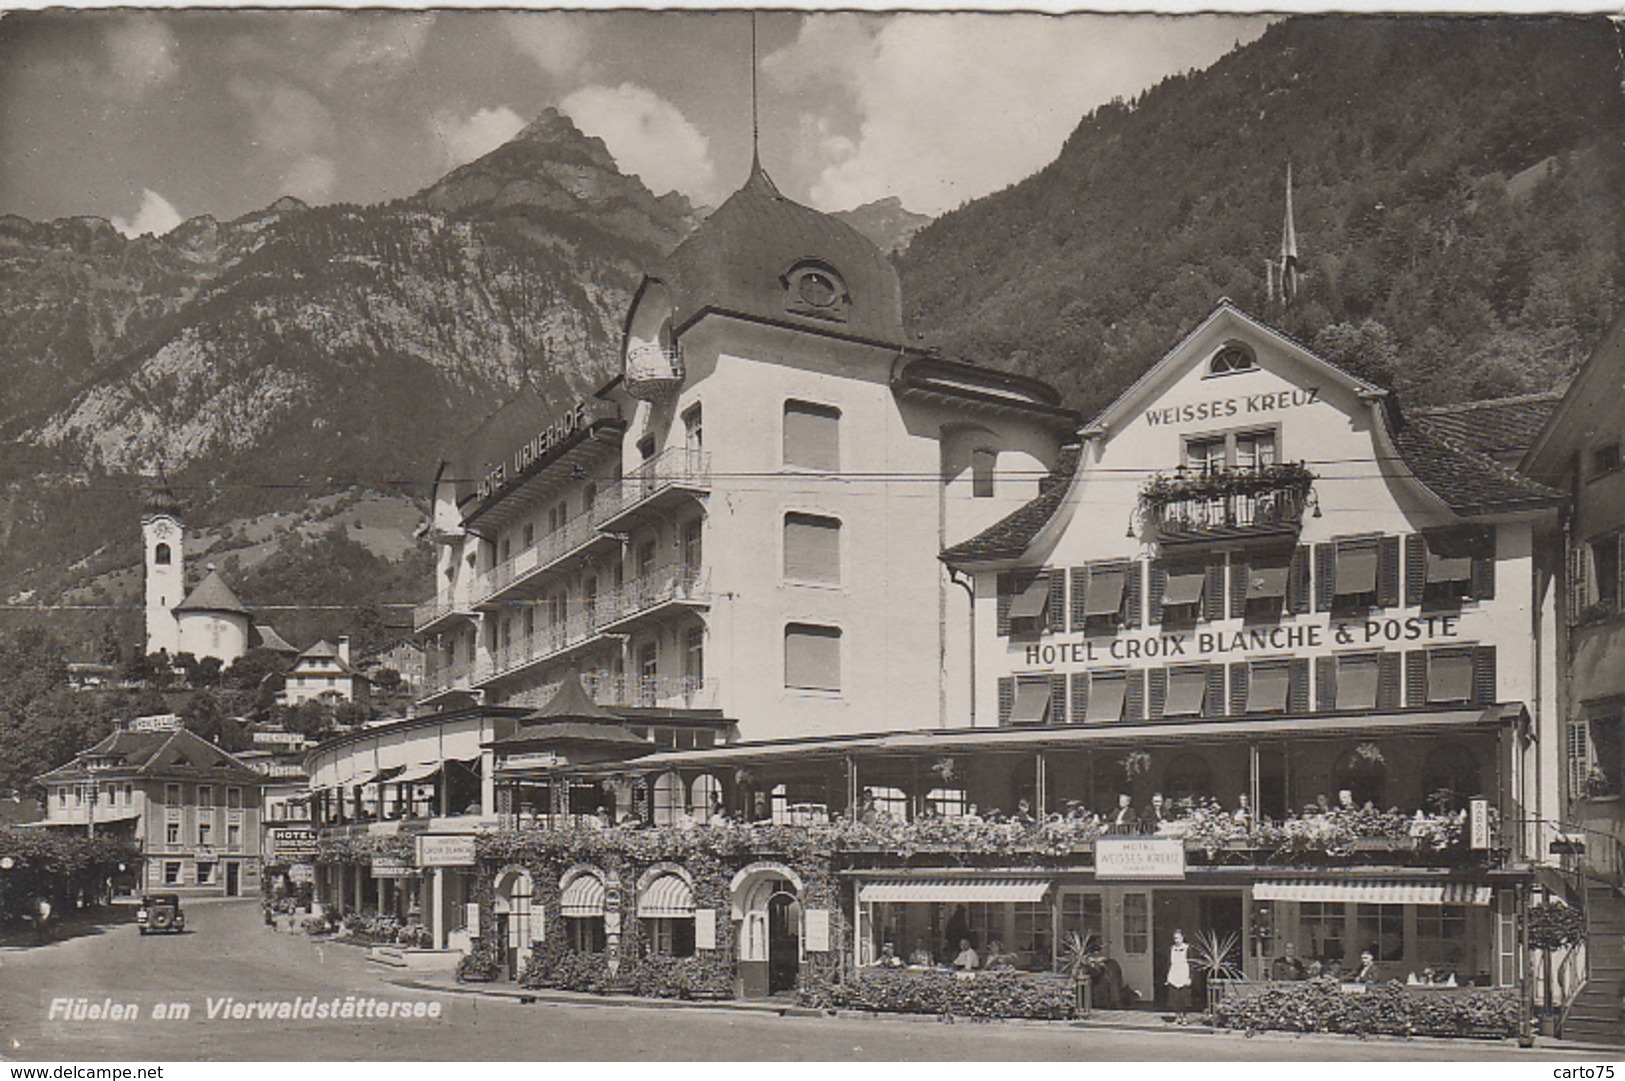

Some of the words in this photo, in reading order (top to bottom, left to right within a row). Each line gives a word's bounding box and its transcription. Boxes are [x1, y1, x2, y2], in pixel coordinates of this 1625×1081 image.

[1146, 399, 1238, 426] WEISSES
[1246, 387, 1321, 413] KREUZ
[477, 461, 508, 502] HOTEL
[513, 401, 586, 473] URNERHOF
[1025, 643, 1099, 666] HOTEL
[1110, 635, 1186, 659] CROIX
[1199, 624, 1323, 653] BLANCHE
[1335, 623, 1355, 644] &
[1363, 616, 1459, 642] POSTE
[1101, 853, 1143, 865] WEISSES
[1123, 843, 1155, 851] HOTEL
